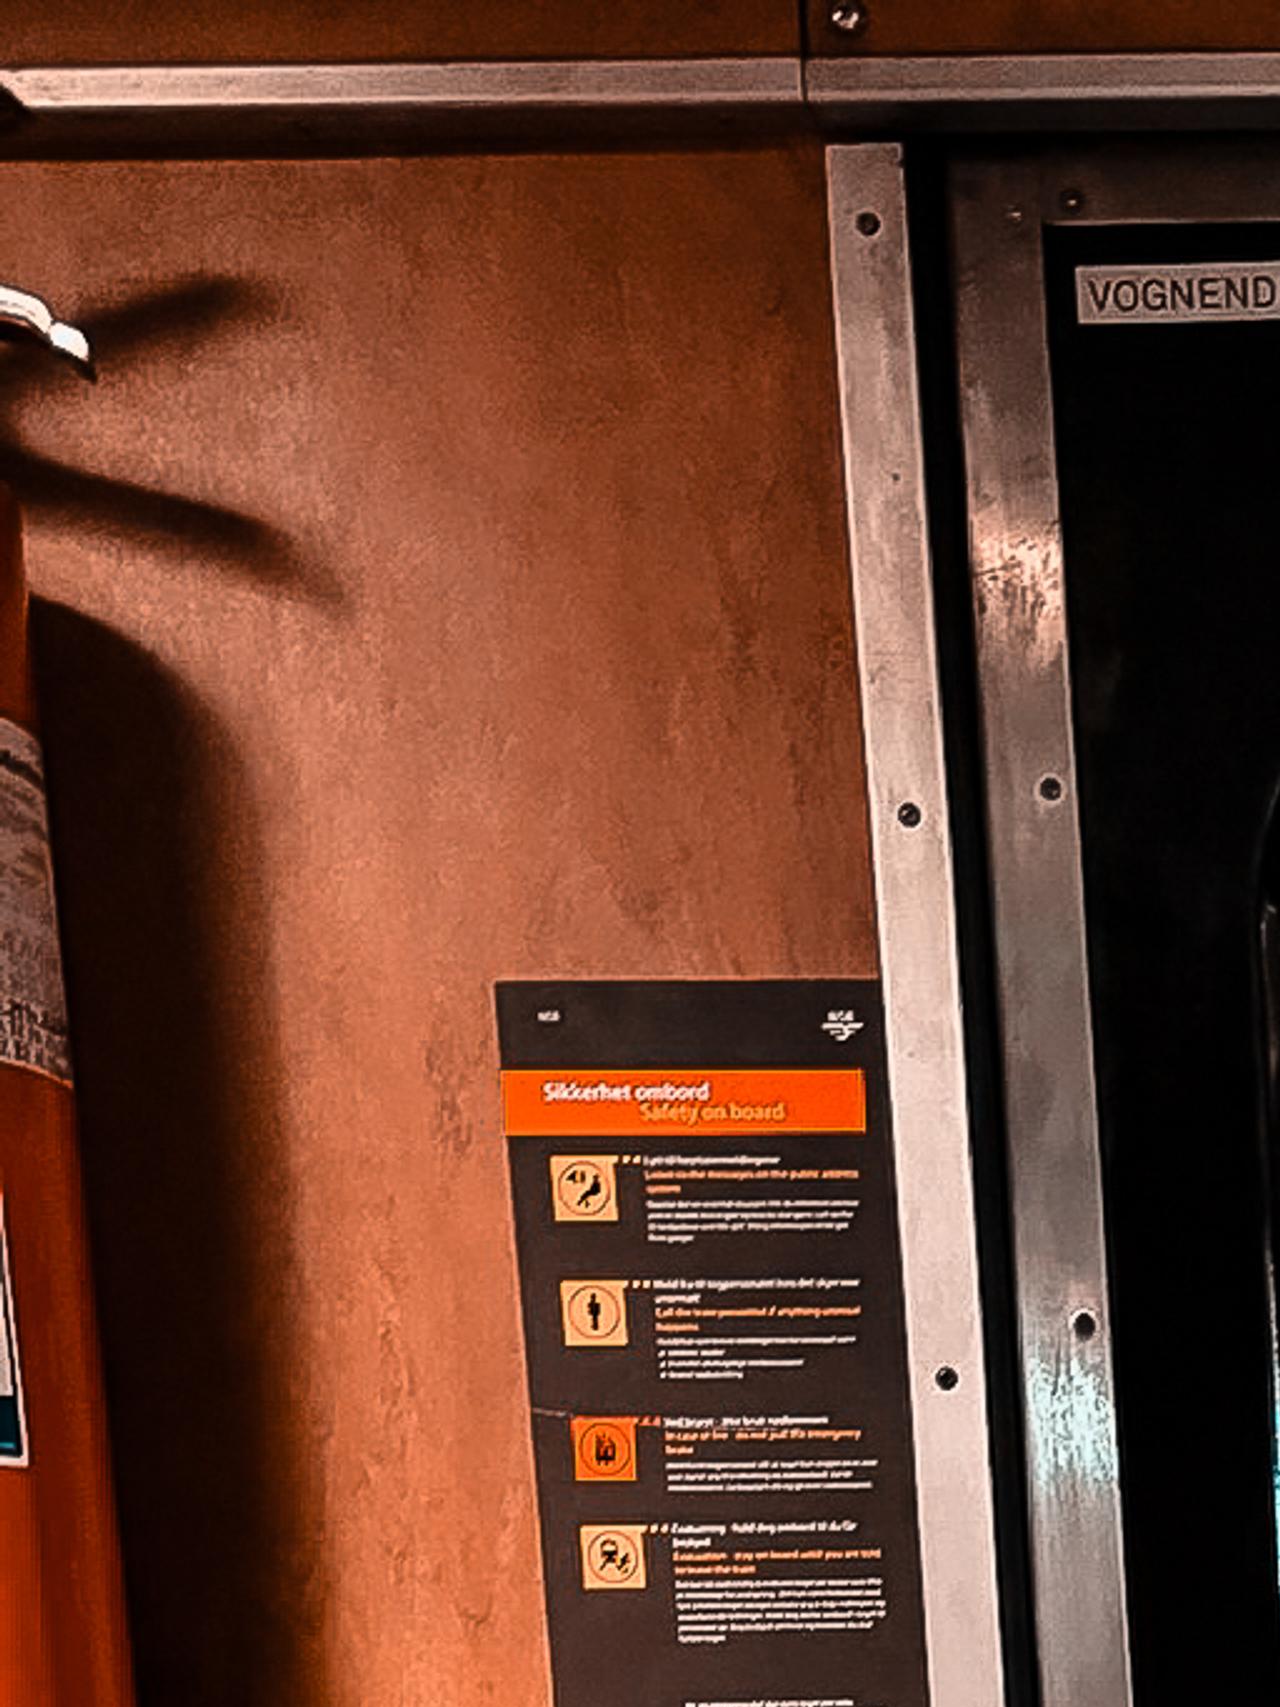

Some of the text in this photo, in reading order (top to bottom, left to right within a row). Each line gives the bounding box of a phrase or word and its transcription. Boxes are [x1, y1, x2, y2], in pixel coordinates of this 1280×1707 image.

[542, 1081, 711, 1102] Sikkerhet ombord
[640, 1102, 786, 1124] Safety on board
